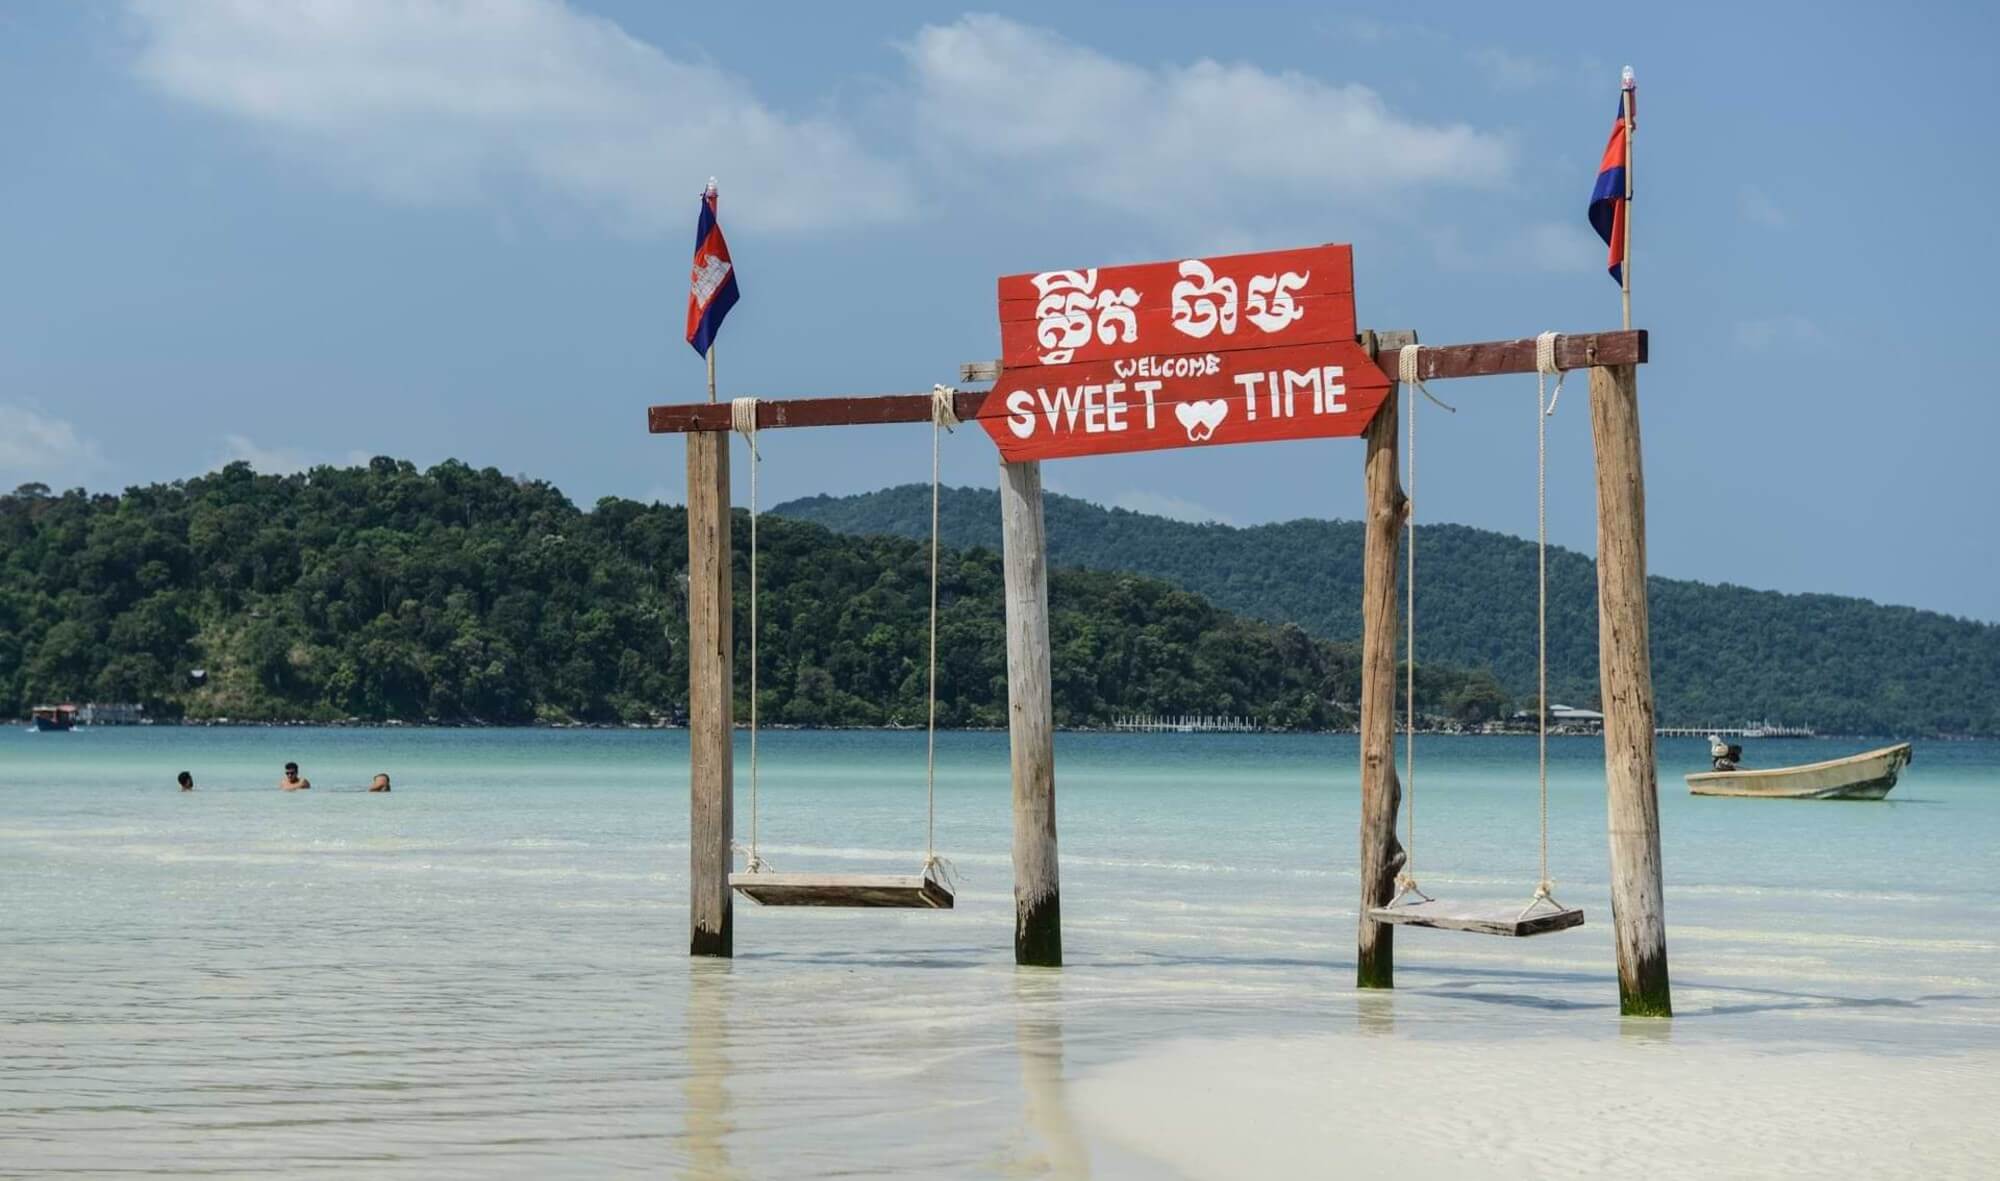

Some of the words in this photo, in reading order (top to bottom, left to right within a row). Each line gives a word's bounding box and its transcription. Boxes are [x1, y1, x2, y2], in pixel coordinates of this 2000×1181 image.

[1113, 353, 1222, 380] WELCOME
[1006, 380, 1161, 439] SWEET
[1233, 366, 1347, 422] TIME
